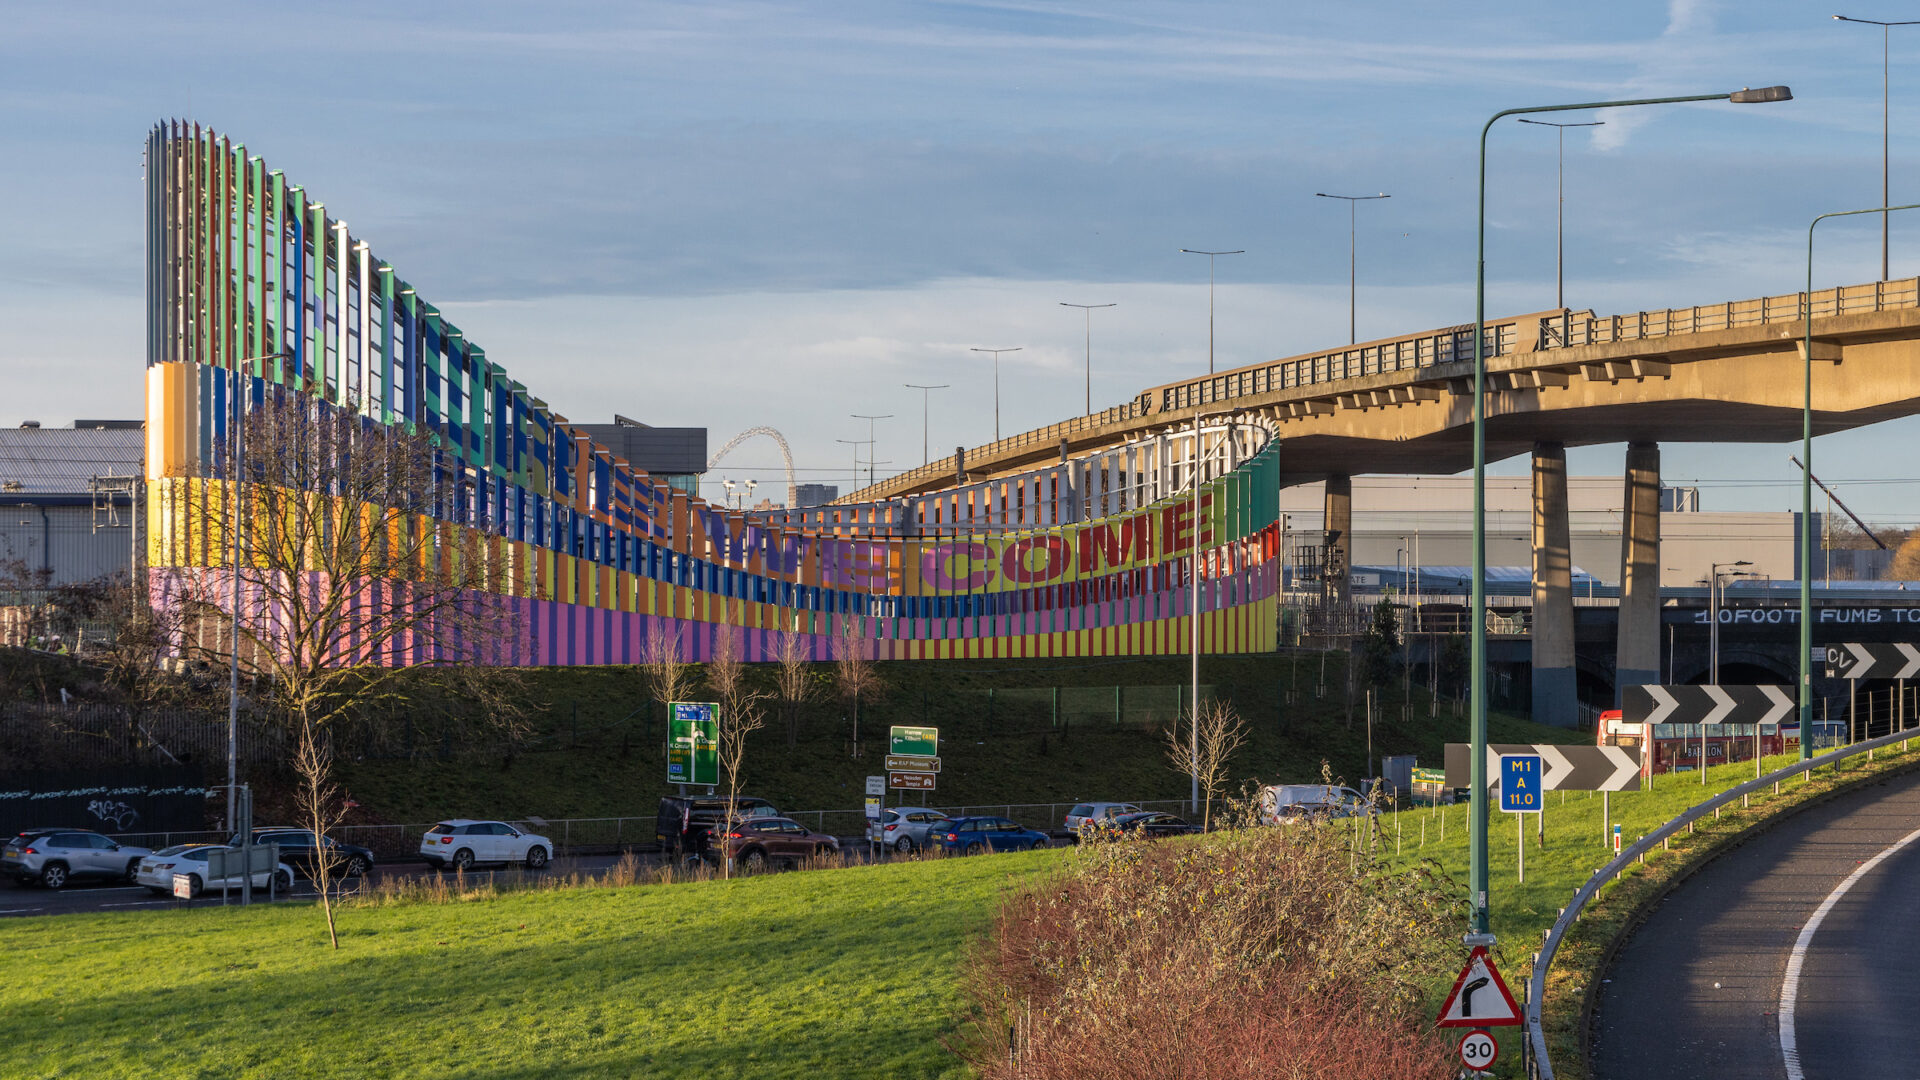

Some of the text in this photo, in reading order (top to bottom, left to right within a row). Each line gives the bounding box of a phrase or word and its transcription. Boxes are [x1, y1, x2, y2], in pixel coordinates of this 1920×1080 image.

[923, 493, 1213, 591] COME
[1695, 608, 1802, 624] 10FOOT
[1820, 608, 1882, 623] FUME
[1688, 747, 1722, 756] BABLON
[1512, 761, 1530, 772] M1
[1517, 777, 1526, 788] A
[1510, 793, 1533, 805] 11.0
[1465, 1042, 1491, 1058] 30
